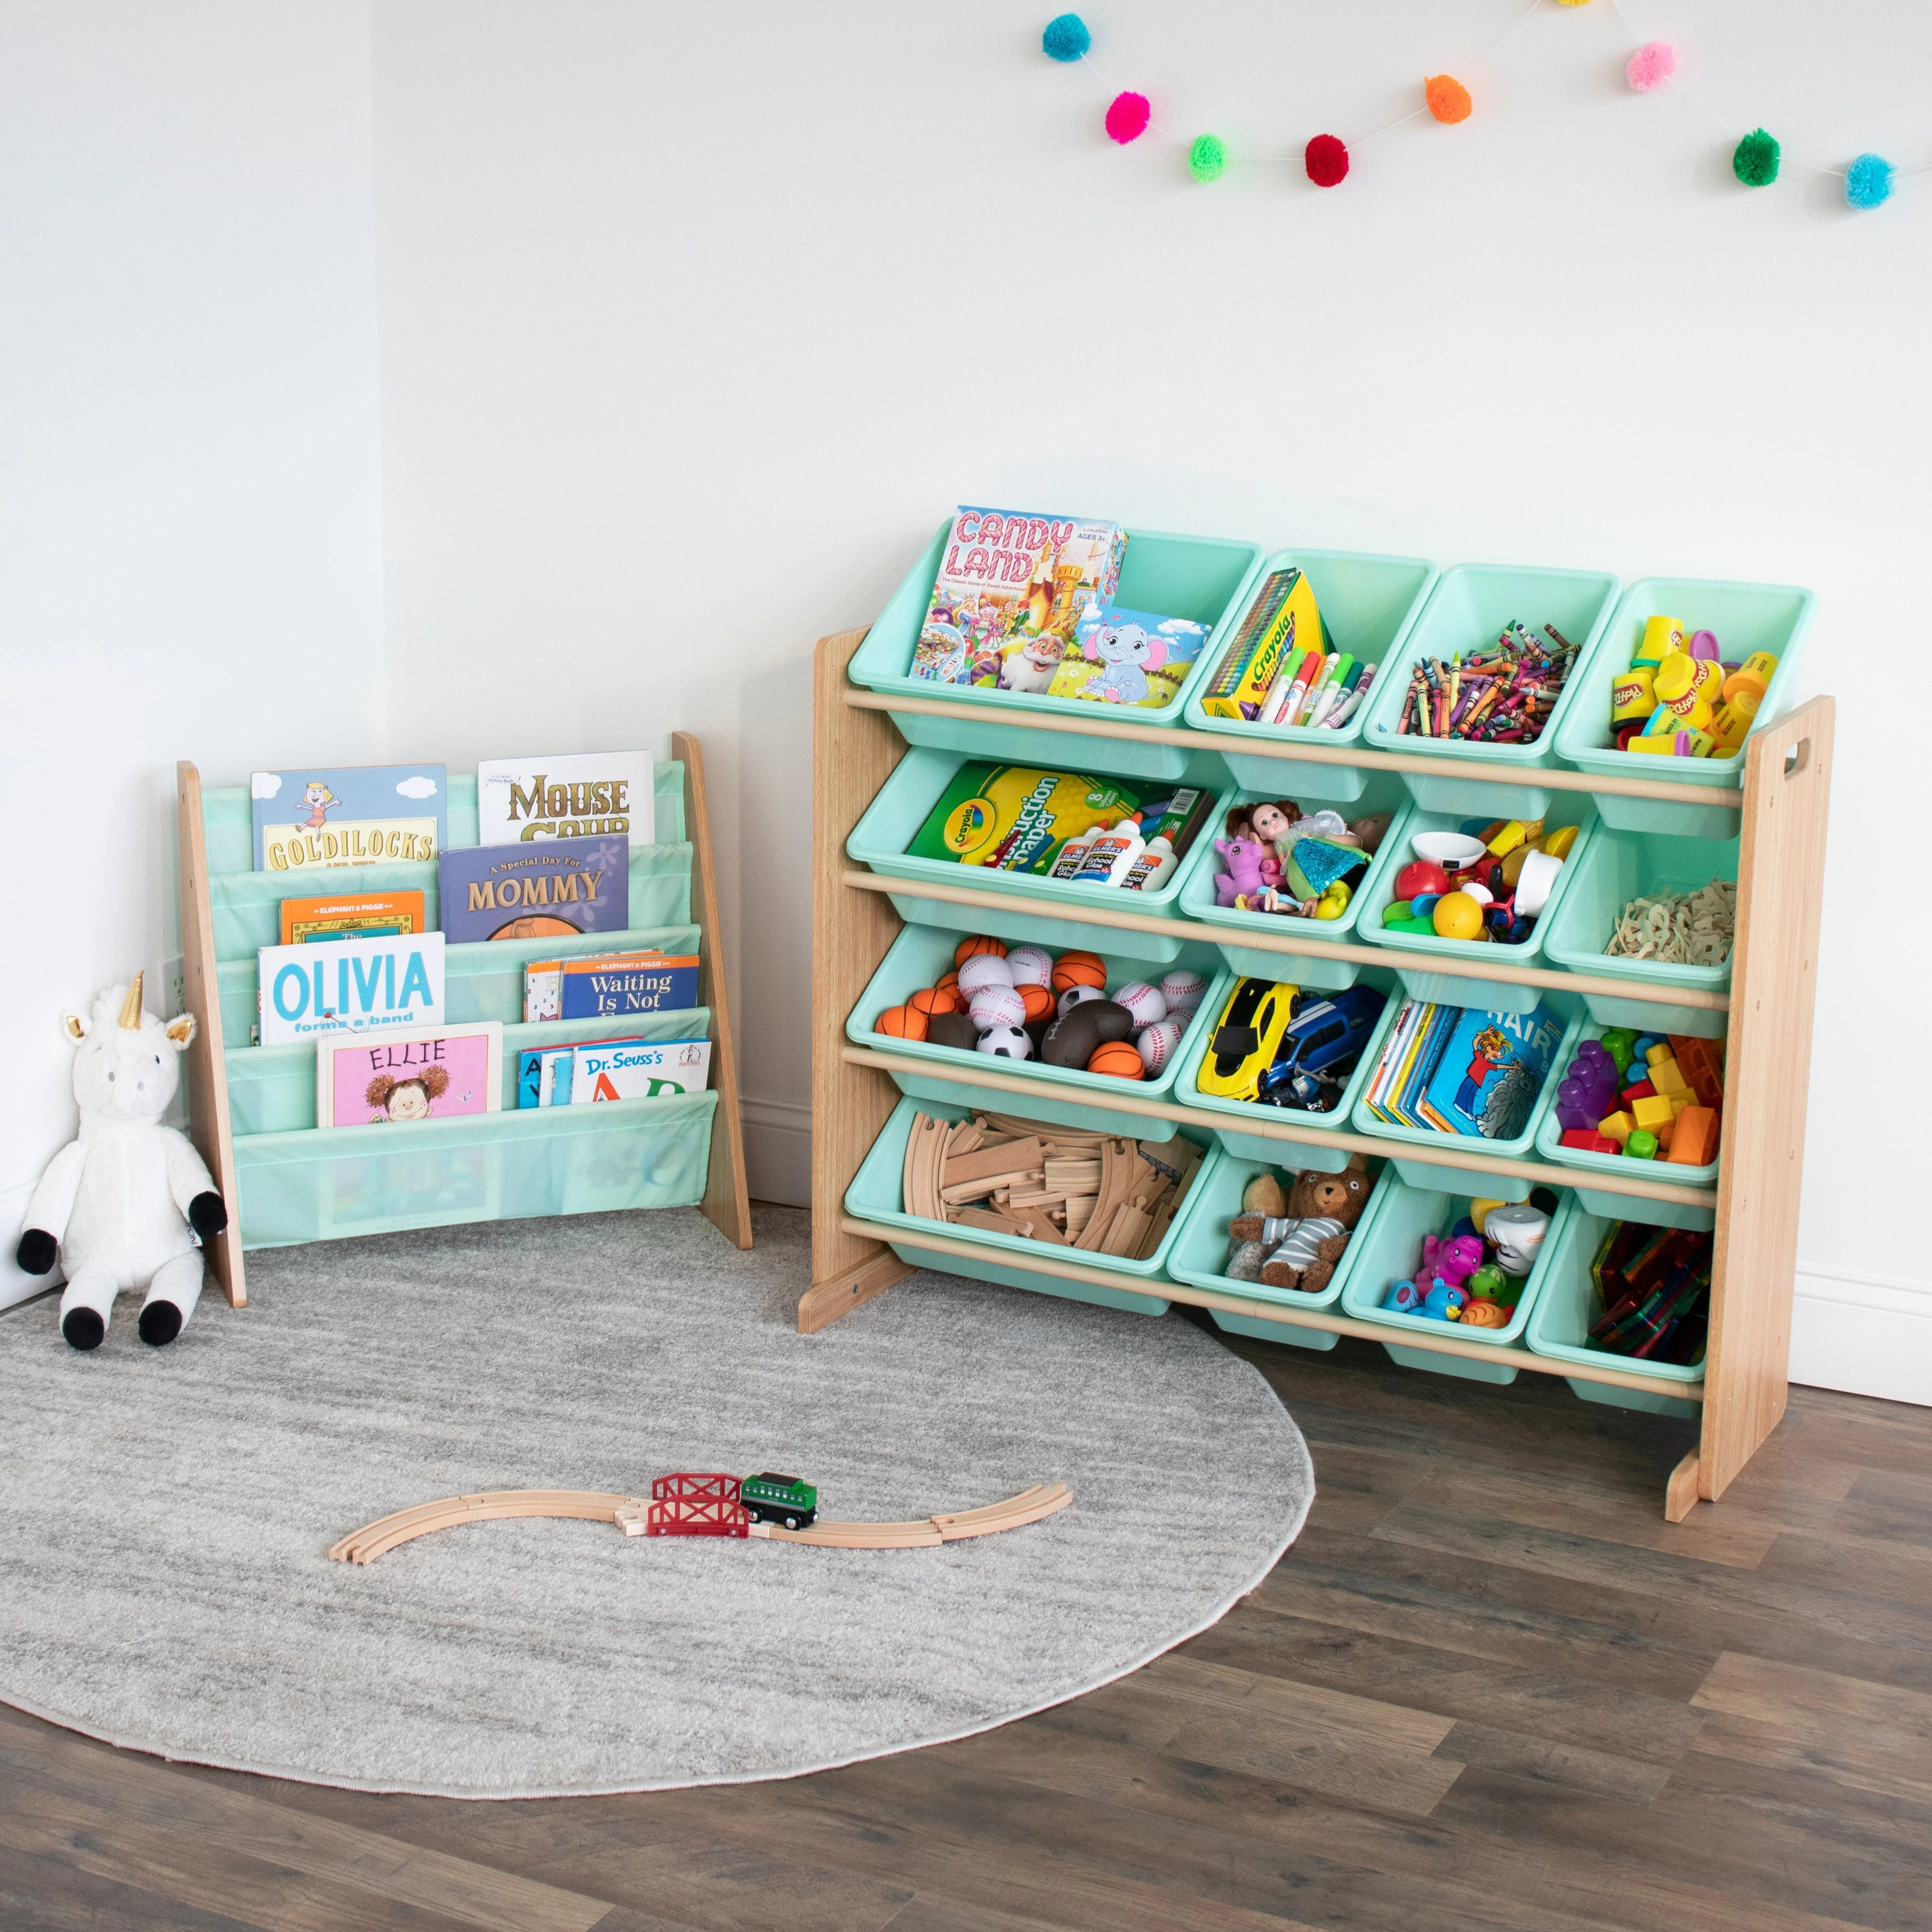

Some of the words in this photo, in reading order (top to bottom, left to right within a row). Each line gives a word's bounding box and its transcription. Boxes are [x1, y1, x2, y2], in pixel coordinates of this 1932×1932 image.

[956, 512, 1074, 554] CANDY
[945, 544, 1034, 582] LAND
[1253, 614, 1291, 680] Crayola
[1403, 697, 1413, 718] Crayola
[1088, 793, 1103, 801] 8
[954, 808, 974, 844] Crayola
[269, 829, 433, 871] GOLDILOCKS
[489, 867, 498, 875] A
[500, 856, 538, 872] Special
[542, 856, 561, 867] Day
[564, 857, 580, 867] For
[468, 870, 604, 912] MOMMY
[320, 905, 355, 914] ELEPHANT
[273, 951, 434, 1021] OLIVIA
[590, 974, 673, 993] Waiting
[597, 994, 617, 1011] Is
[625, 992, 661, 1010] Not
[294, 1021, 346, 1033] forms
[354, 1018, 364, 1027] a
[370, 1012, 414, 1025] band
[370, 1039, 446, 1070] ELLIE
[586, 1058, 611, 1075] Dr.
[613, 1050, 664, 1069] Seuss's
